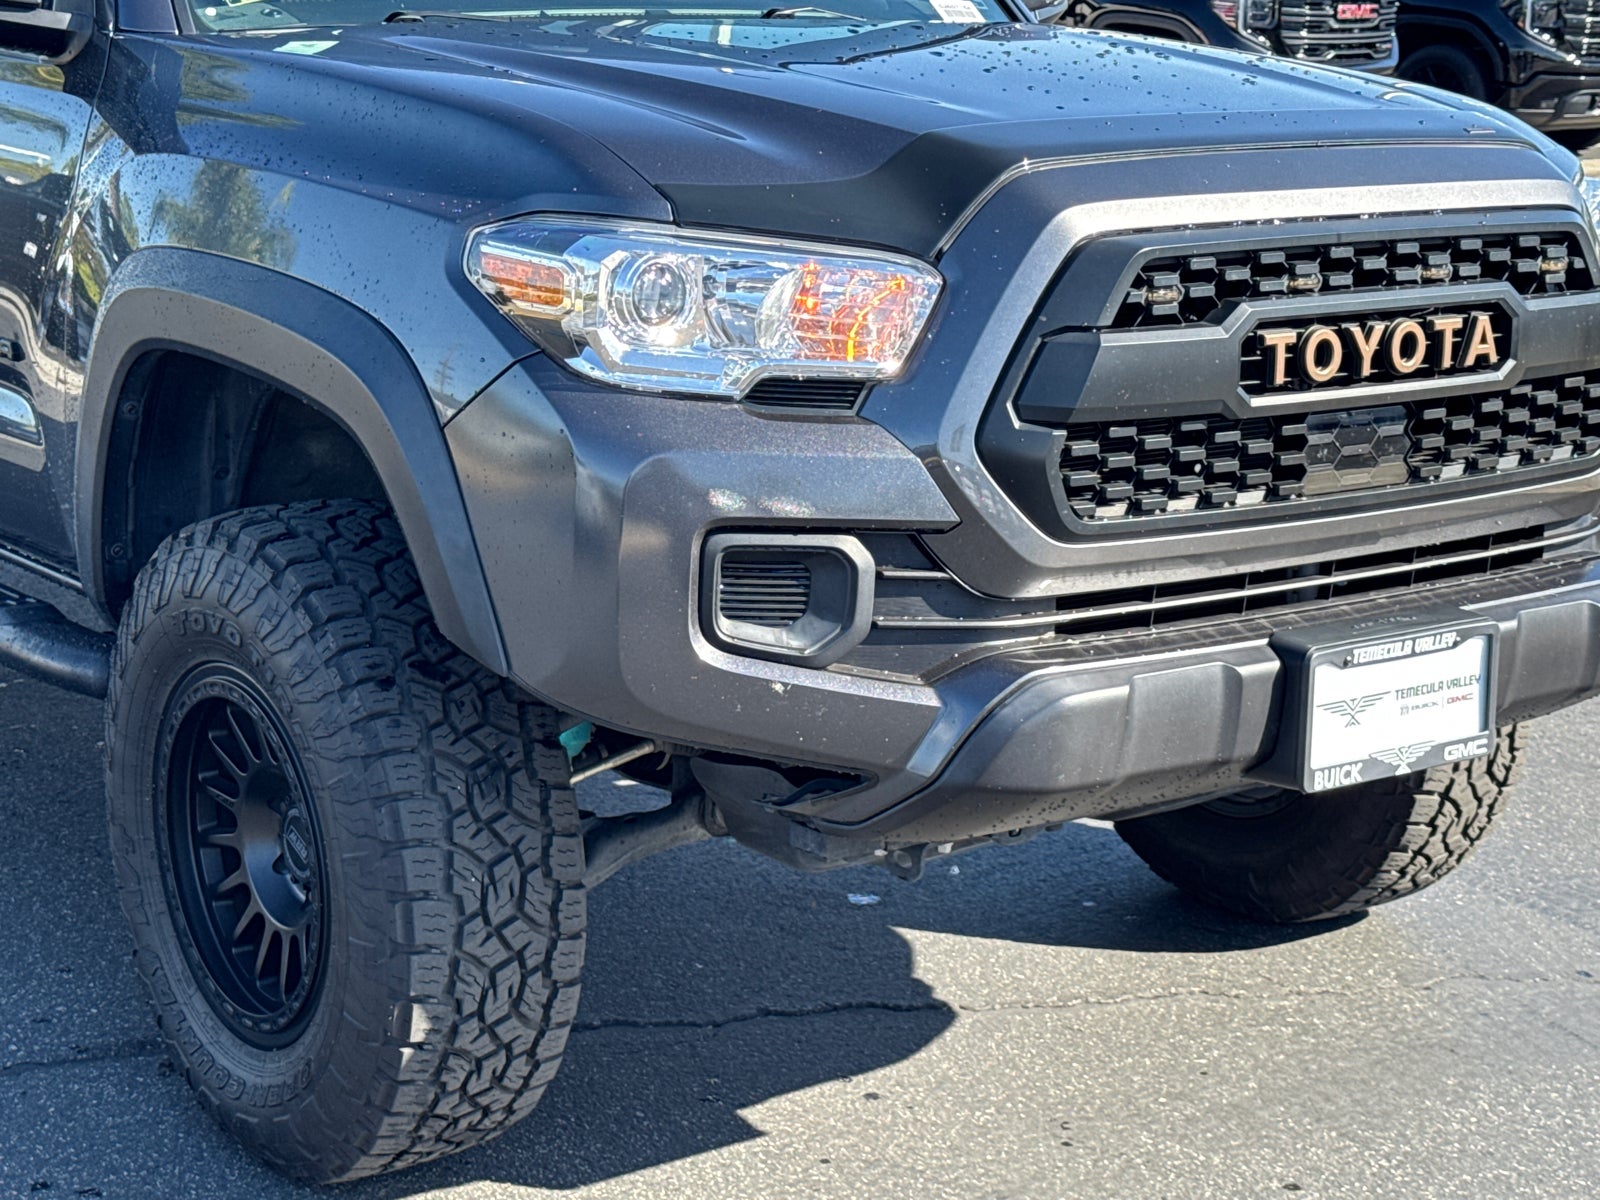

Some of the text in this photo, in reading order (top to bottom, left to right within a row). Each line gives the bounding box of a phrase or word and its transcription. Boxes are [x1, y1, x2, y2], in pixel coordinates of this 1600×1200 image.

[1337, 4, 1379, 19] GMC
[1258, 311, 1498, 386] TOYOTA
[171, 607, 243, 649] TOYO
[1352, 632, 1457, 664] TEMECULA VALLEY
[1394, 673, 1481, 701] TEMECULA VALLEY
[1446, 692, 1474, 704] GMC
[1411, 701, 1439, 710] BUICK
[1443, 738, 1489, 761] GMC
[1313, 762, 1364, 791] BUICK
